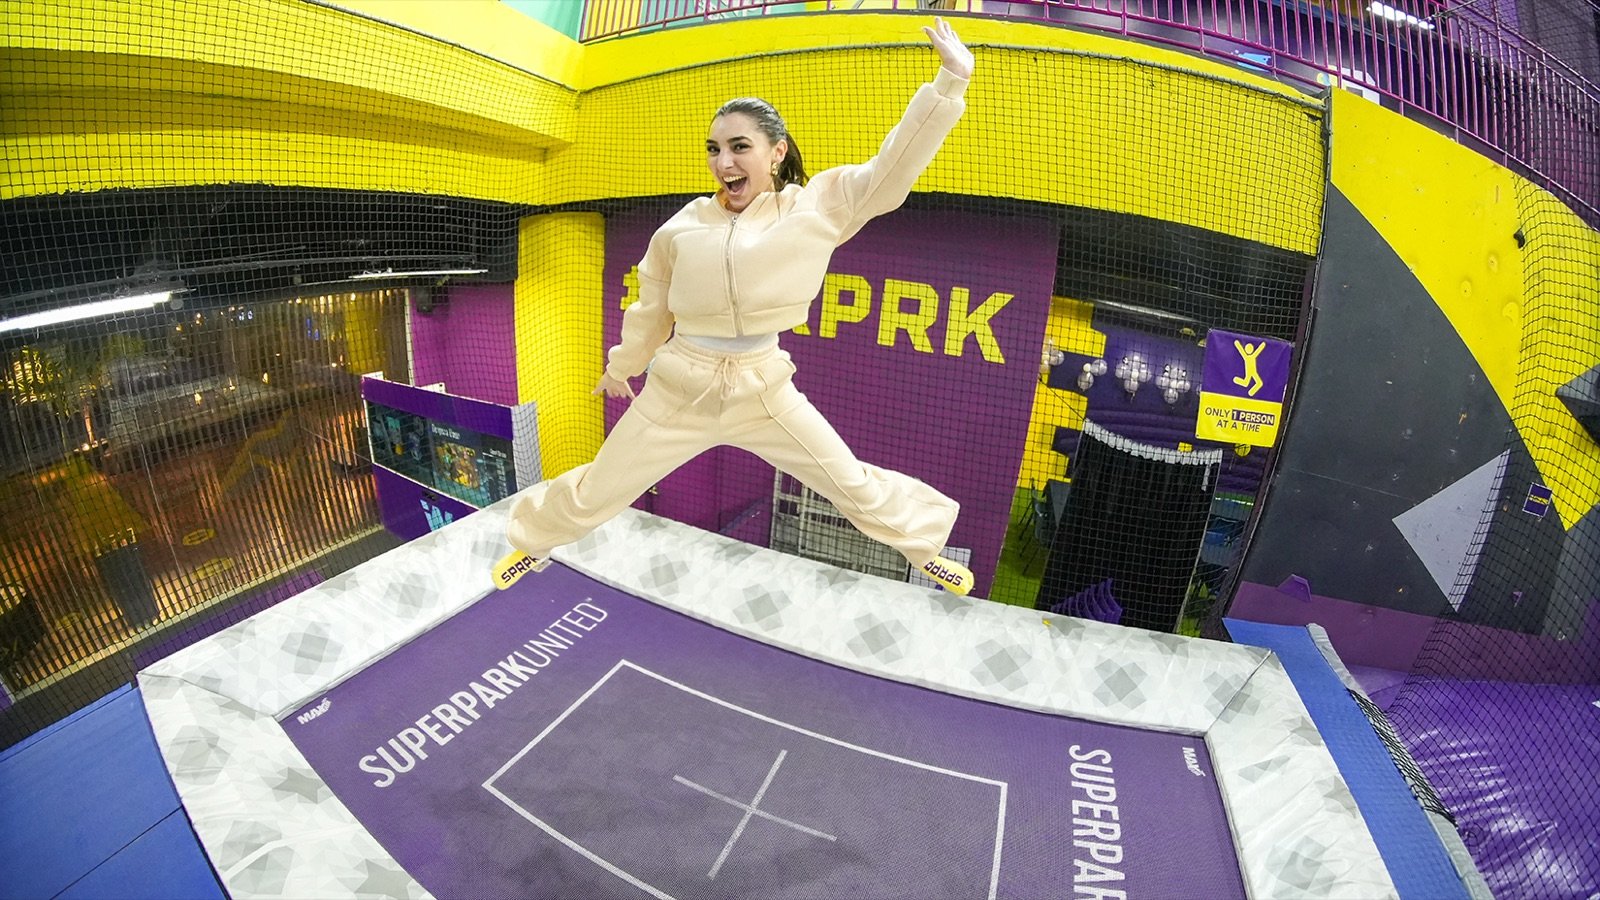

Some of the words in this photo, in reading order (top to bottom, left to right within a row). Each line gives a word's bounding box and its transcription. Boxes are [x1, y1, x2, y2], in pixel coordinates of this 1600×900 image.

[1206, 407, 1230, 418] ONLY
[1232, 411, 1238, 420] 1
[1239, 411, 1274, 424] PERSON
[1217, 419, 1229, 428] AT
[1232, 421, 1238, 430] A
[1242, 423, 1261, 432] TIME
